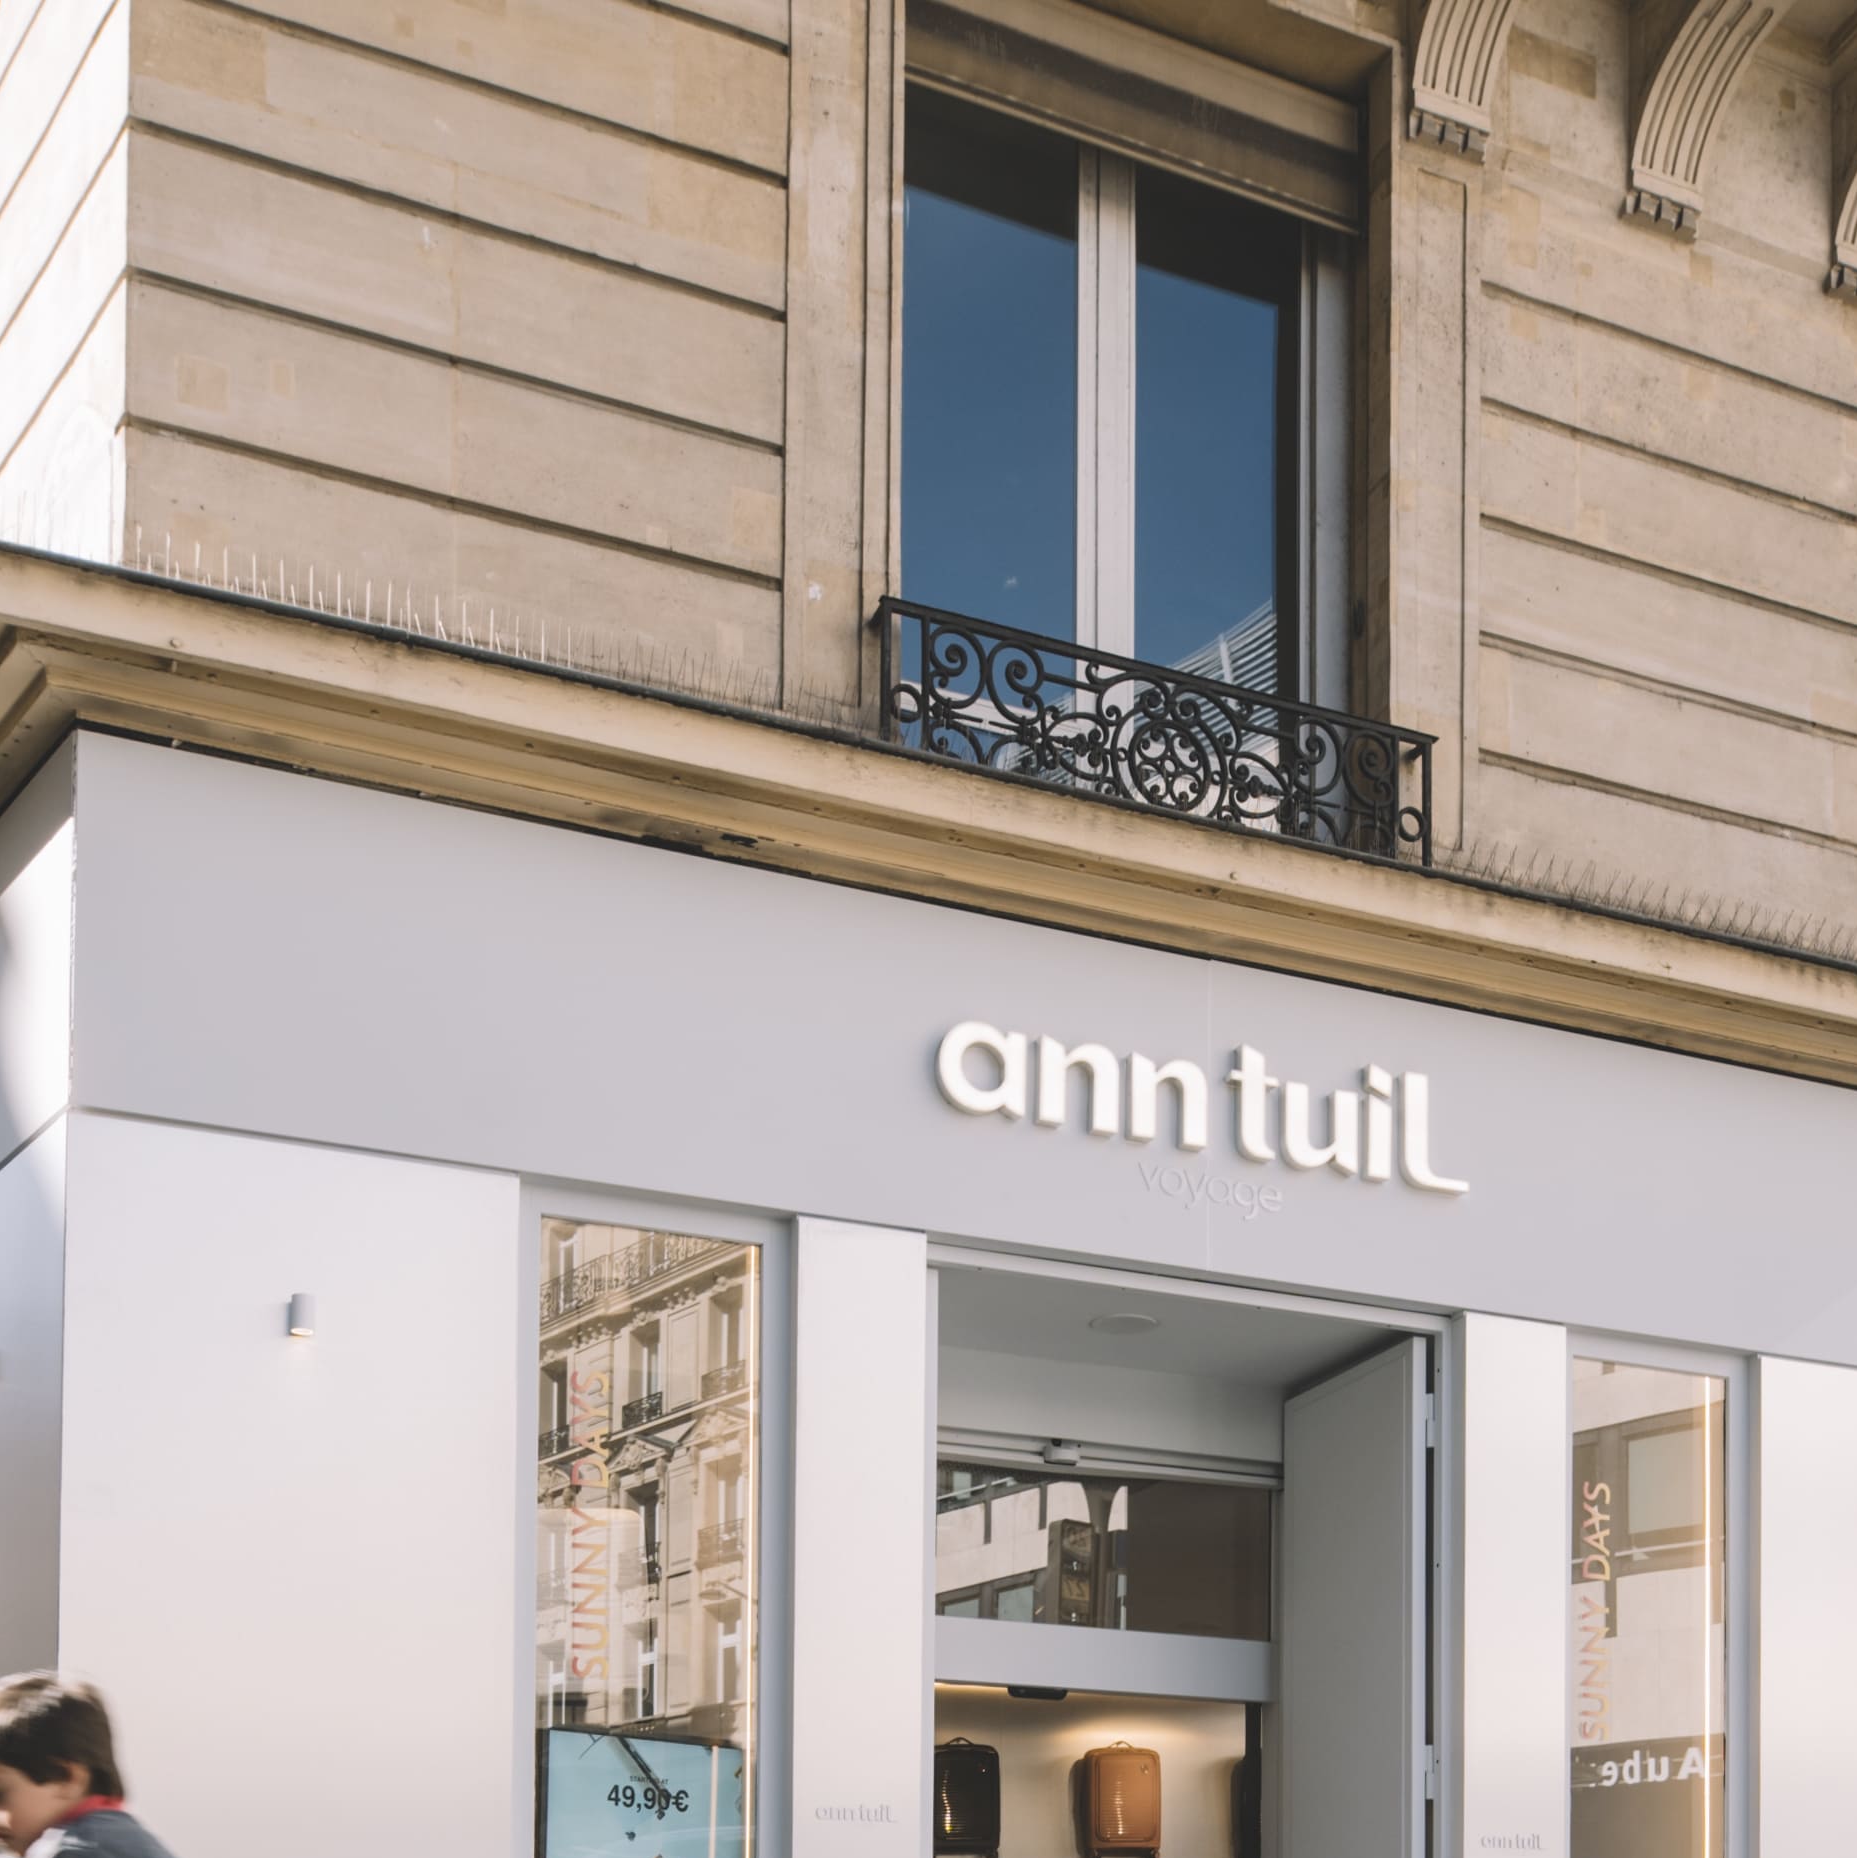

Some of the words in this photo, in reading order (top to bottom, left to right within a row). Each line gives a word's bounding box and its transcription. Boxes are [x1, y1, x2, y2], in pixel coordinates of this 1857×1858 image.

[937, 1020, 1207, 1152] ann
[1224, 1043, 1470, 1197] tuil
[1137, 1161, 1284, 1220] voyage
[571, 1371, 609, 1488] DAYS
[1582, 1481, 1611, 1581] DAYS
[571, 1507, 610, 1680] SUNNY
[1578, 1596, 1610, 1741] SUNNY
[607, 1784, 690, 1813] 49,90€
